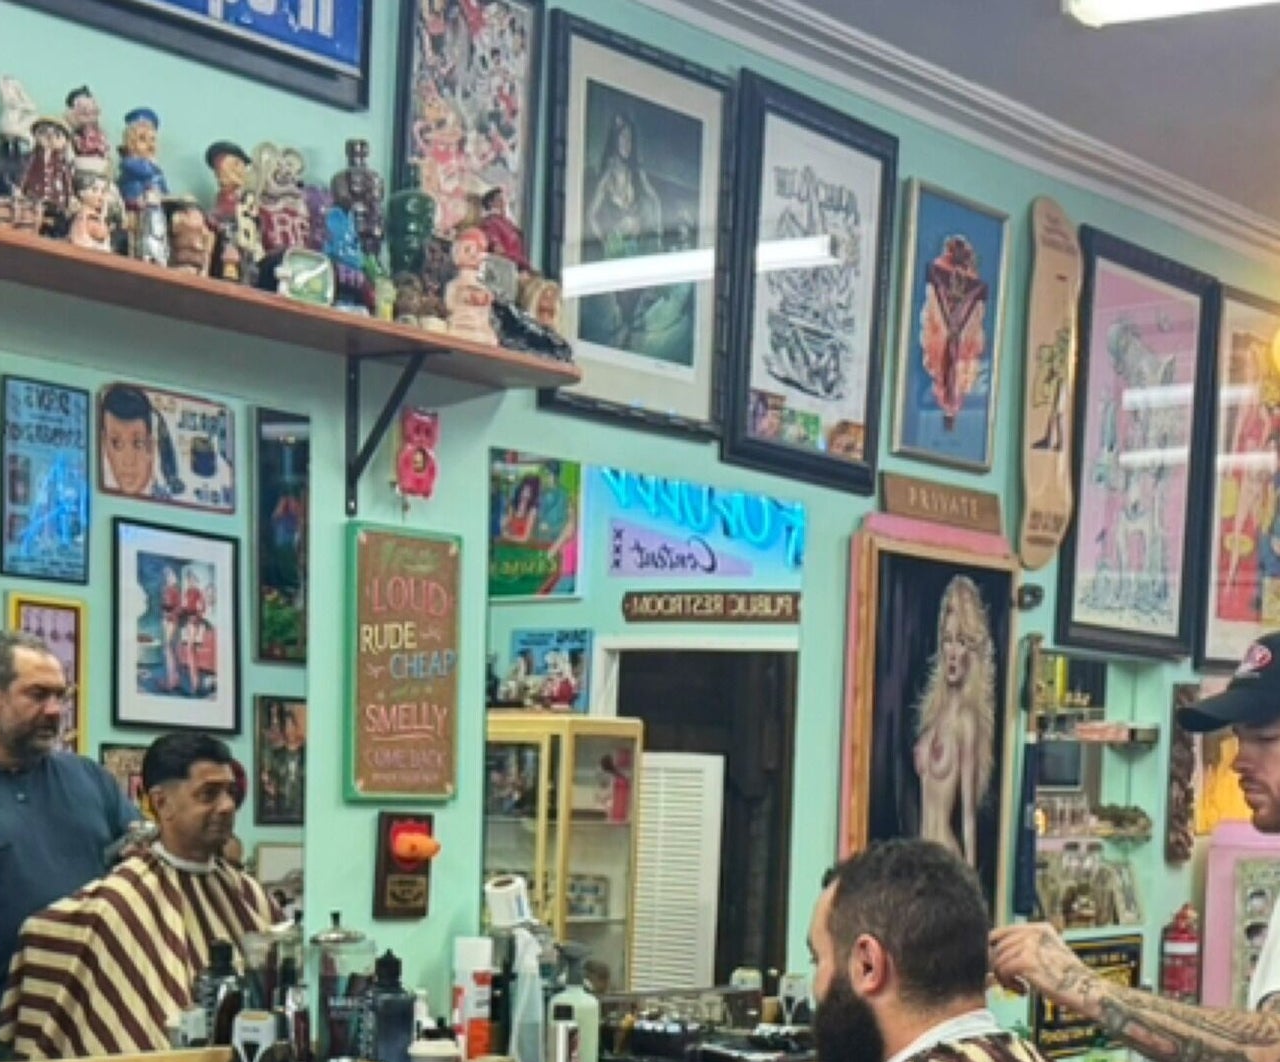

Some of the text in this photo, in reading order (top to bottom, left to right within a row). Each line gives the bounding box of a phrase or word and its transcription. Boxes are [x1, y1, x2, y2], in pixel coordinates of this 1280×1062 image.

[909, 486, 980, 521] PRIVATE
[369, 575, 450, 617] LOUD
[360, 622, 418, 656] RUDE
[389, 650, 456, 682] CHEAP
[365, 701, 448, 737] SMELLY
